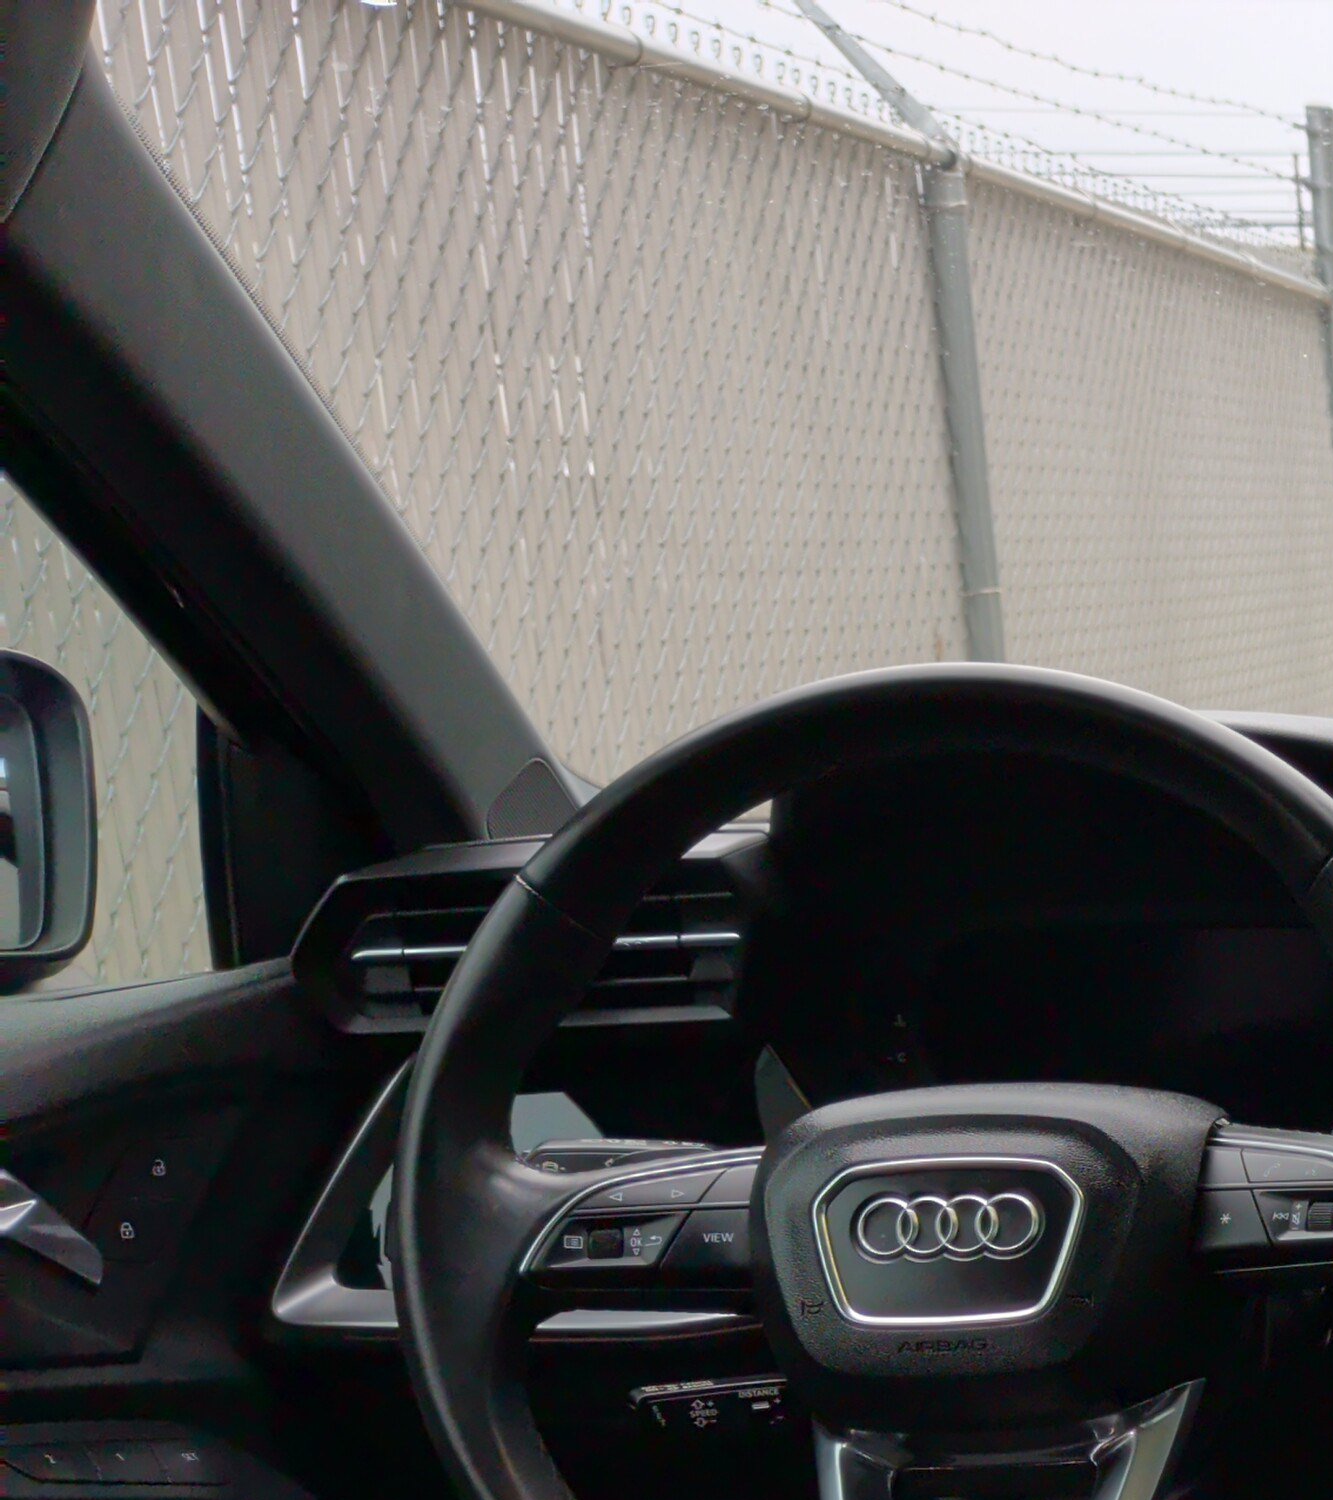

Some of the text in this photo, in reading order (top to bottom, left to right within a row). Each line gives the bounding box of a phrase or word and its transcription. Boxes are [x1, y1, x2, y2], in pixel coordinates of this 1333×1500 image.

[630, 1237, 643, 1247] OK
[702, 1232, 735, 1243] VIEW
[738, 1387, 780, 1399] DISTANCE
